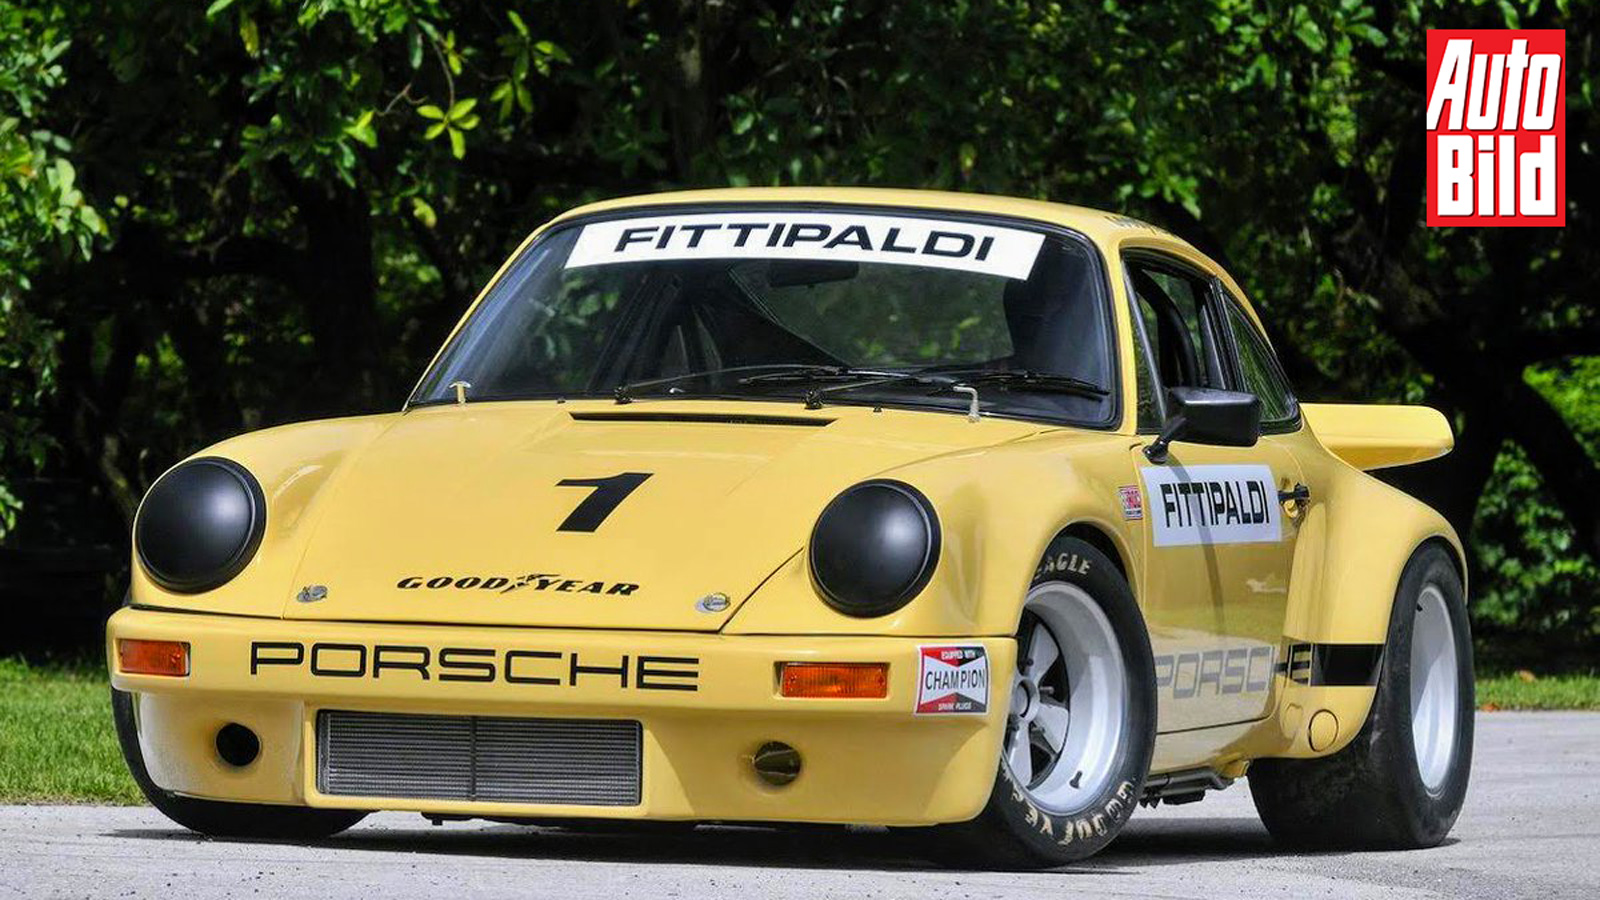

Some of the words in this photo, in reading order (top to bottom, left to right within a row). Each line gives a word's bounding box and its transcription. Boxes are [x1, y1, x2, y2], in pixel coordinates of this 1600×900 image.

[613, 222, 995, 263] FITTIPALDI
[555, 472, 653, 532] 1
[1159, 480, 1270, 528] FITTIPALDI
[250, 641, 700, 691] PORSCHE
[925, 669, 985, 690] CHAMPION
